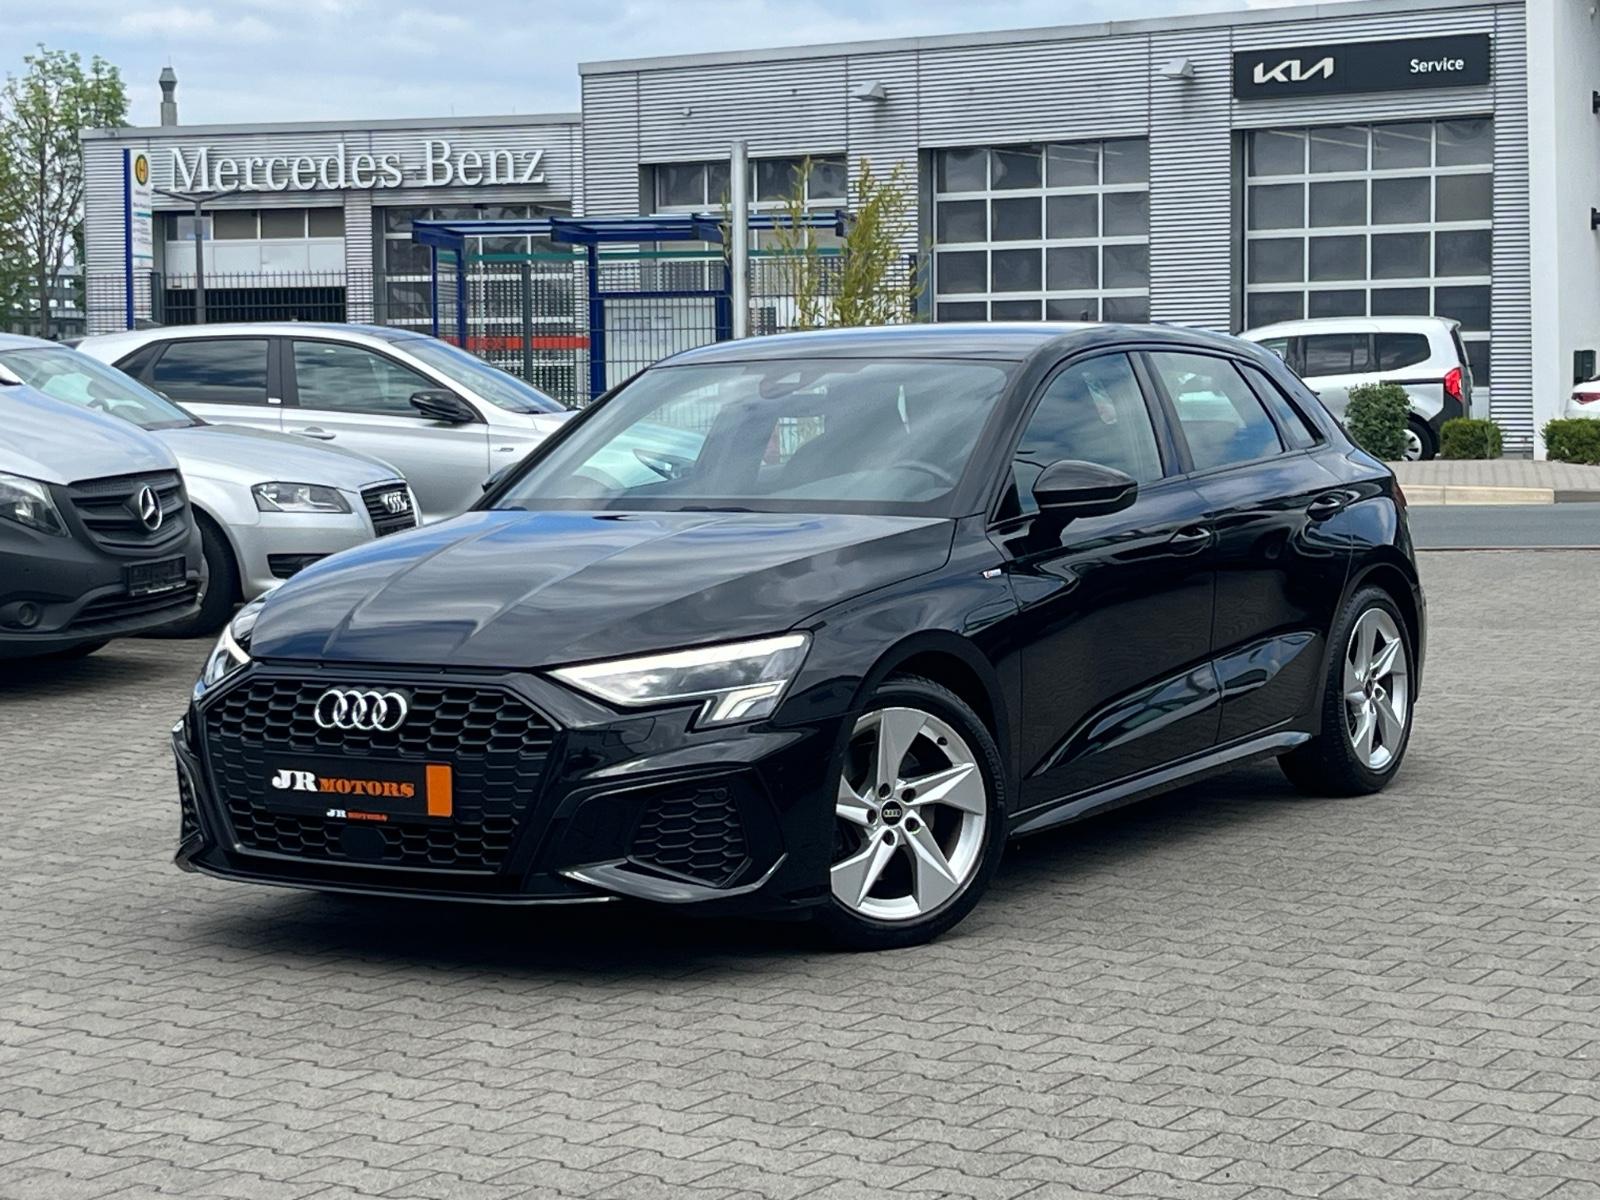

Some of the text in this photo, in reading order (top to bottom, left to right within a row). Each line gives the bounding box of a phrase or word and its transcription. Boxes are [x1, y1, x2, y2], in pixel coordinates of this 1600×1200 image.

[1253, 57, 1465, 84] KIA Service
[170, 139, 545, 193] Mercedes-Benz
[272, 769, 415, 798] JR MOTORS
[326, 808, 347, 819] JR
